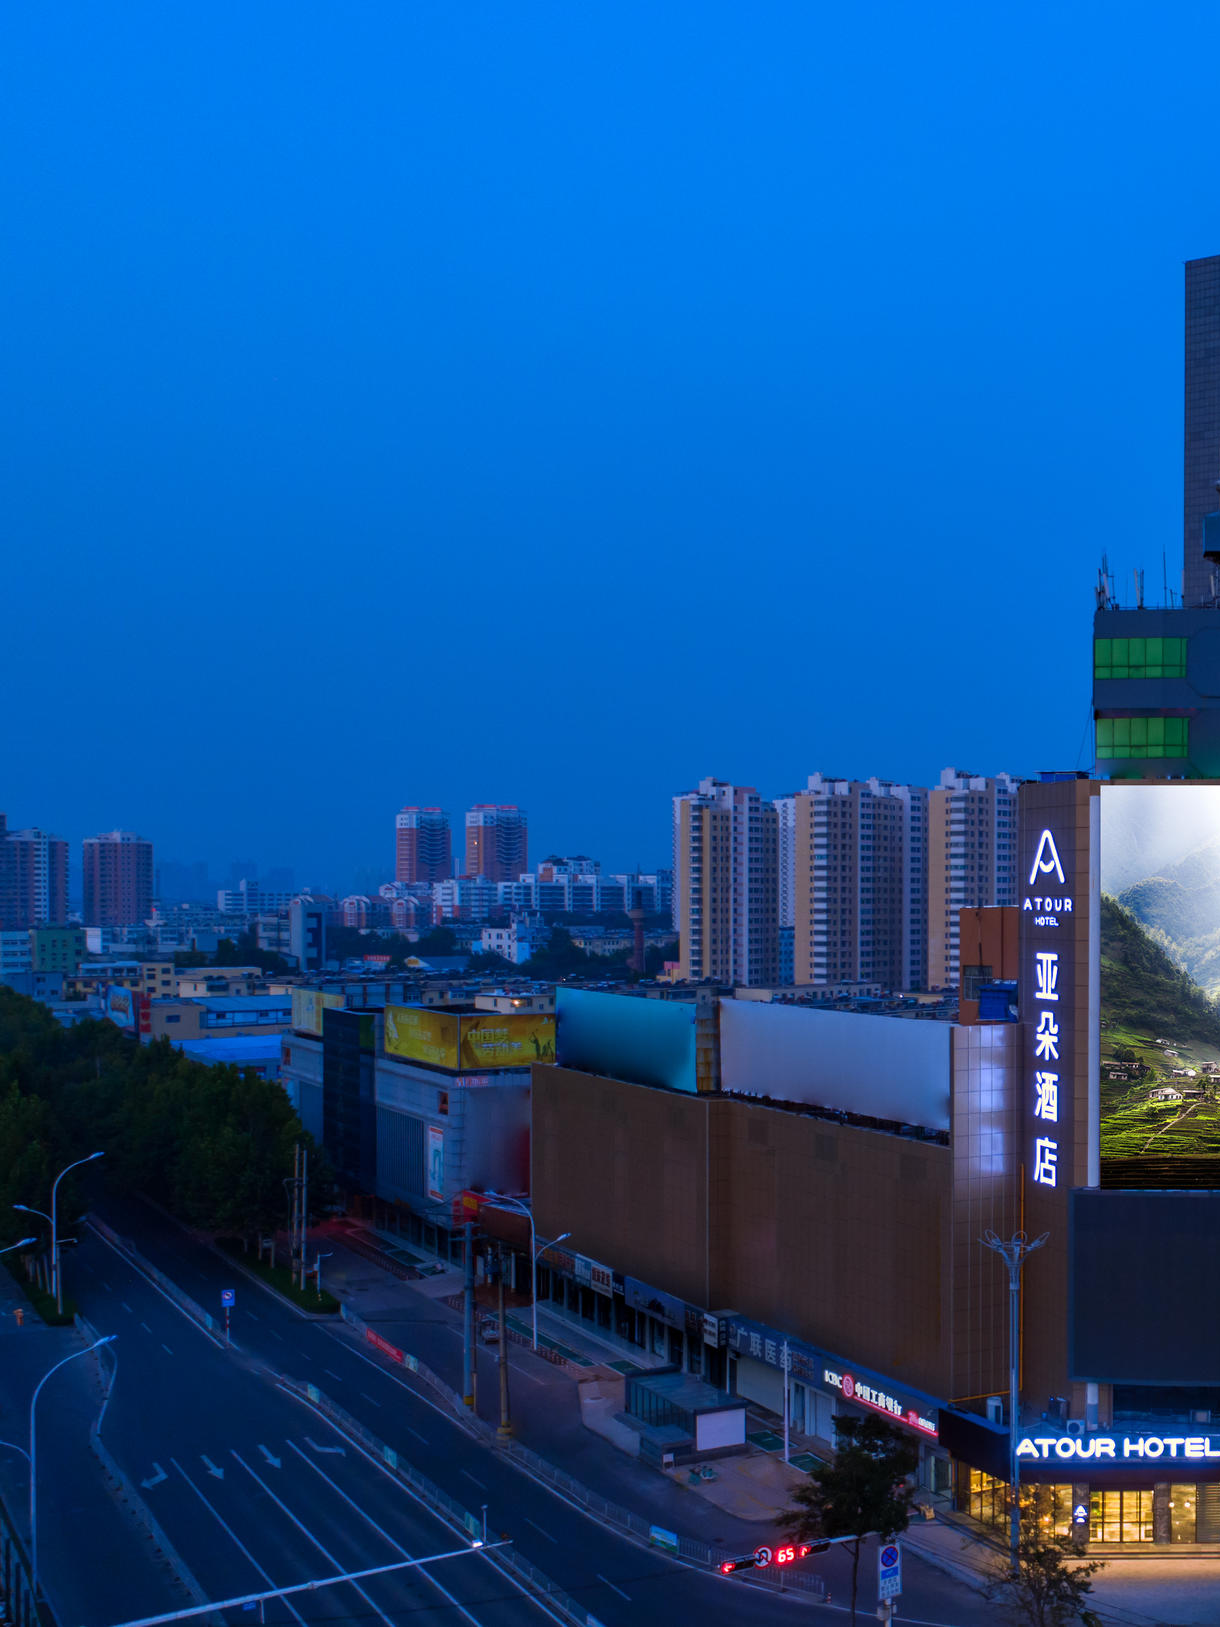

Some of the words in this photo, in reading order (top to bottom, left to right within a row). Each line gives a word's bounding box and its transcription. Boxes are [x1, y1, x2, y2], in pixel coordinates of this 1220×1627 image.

[1023, 896, 1073, 912] ATOUR
[1034, 916, 1059, 927] HOTEL
[1033, 952, 1059, 1188] 亚朵酒店
[736, 1326, 793, 1372] 广联医药
[854, 1382, 903, 1417] 中国工商银行
[1016, 1437, 1116, 1459] ATOUR
[777, 1547, 795, 1563] 65
